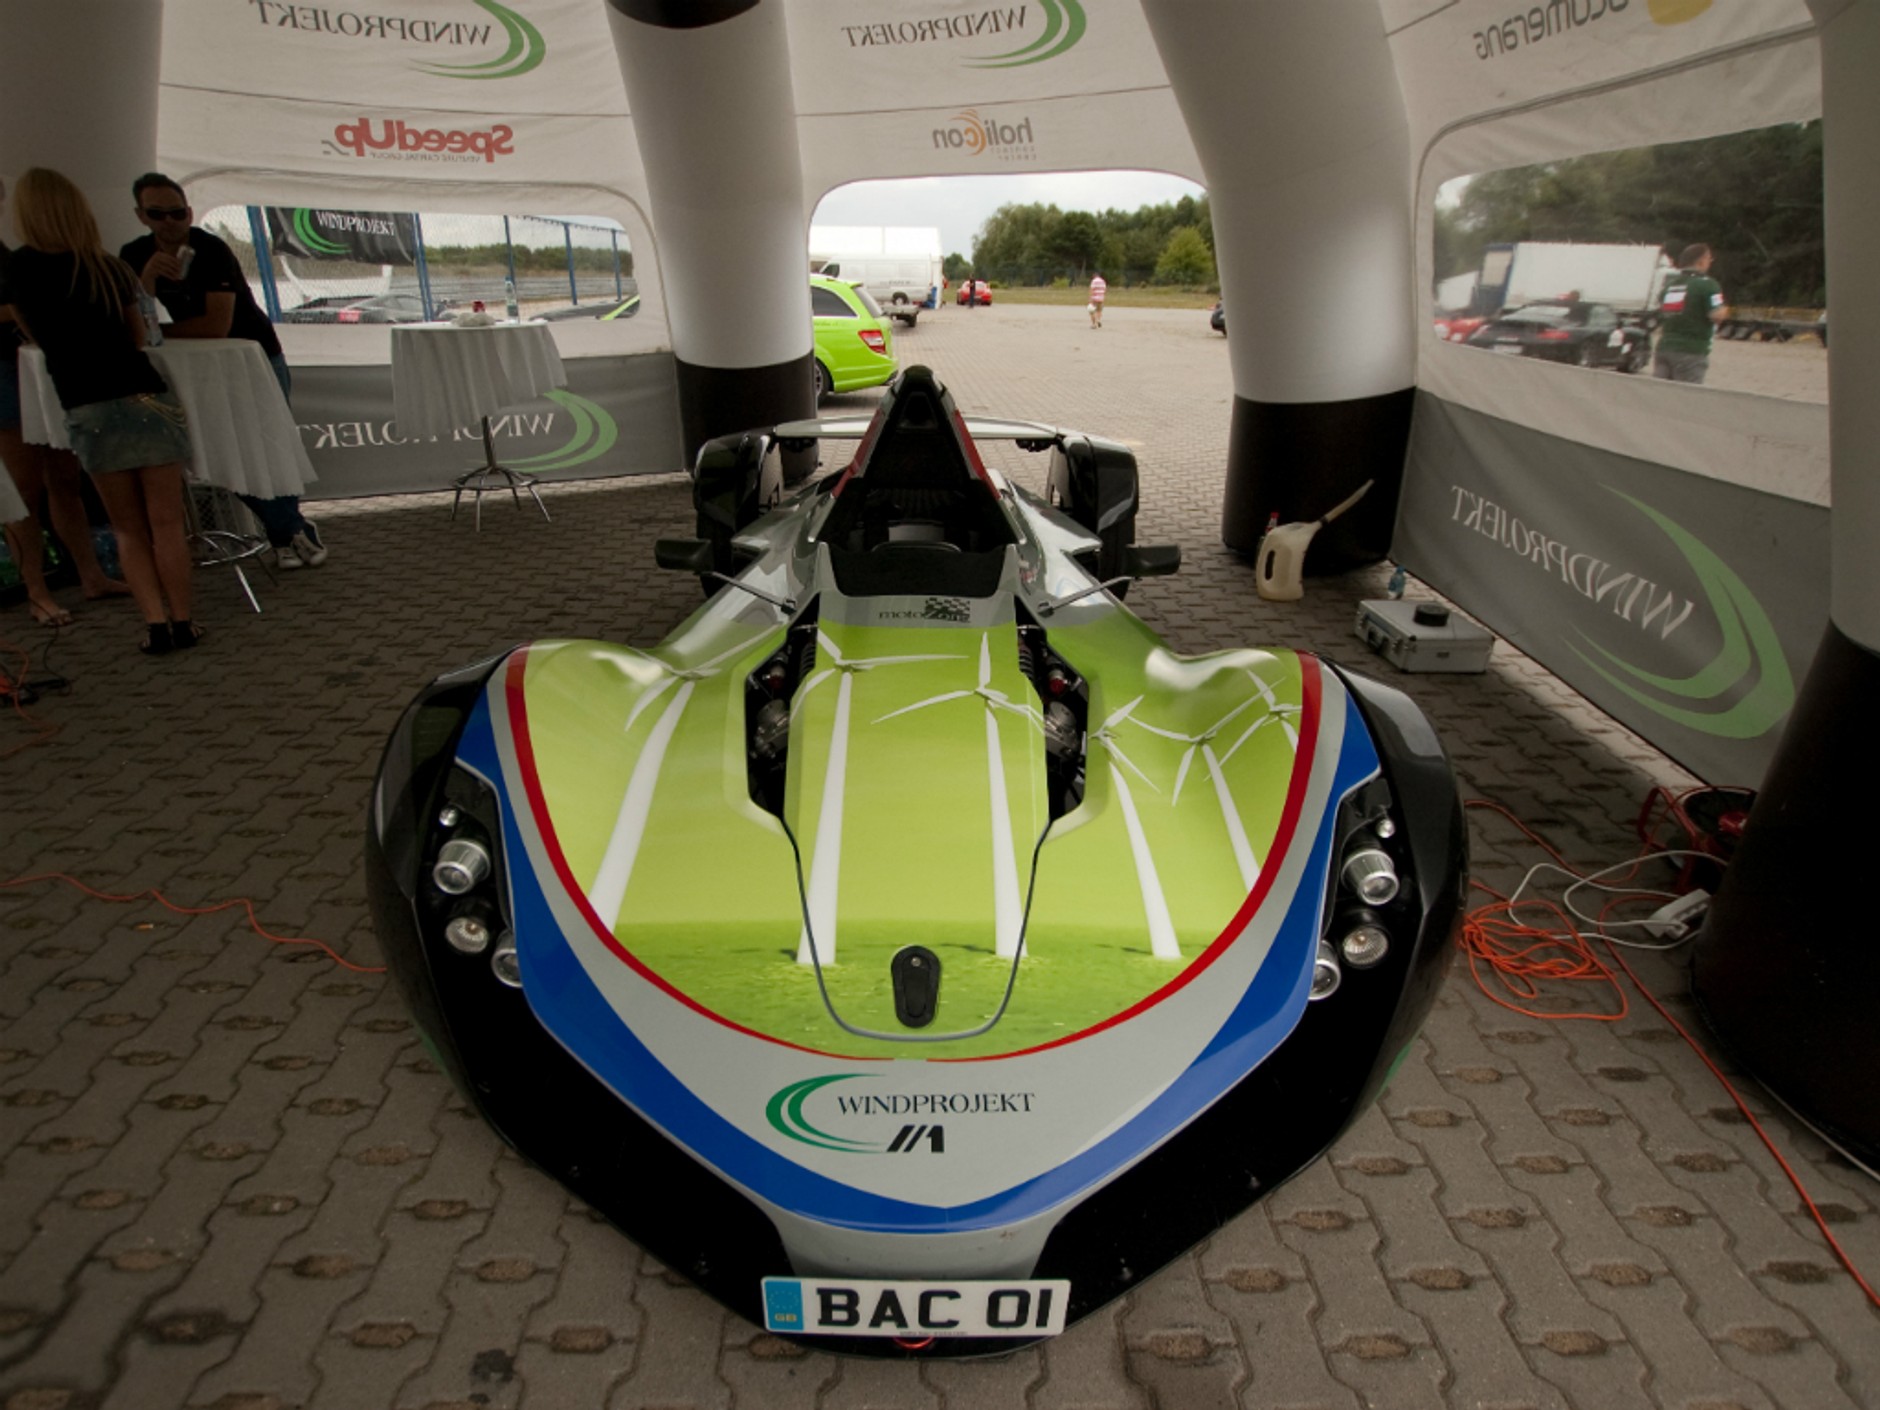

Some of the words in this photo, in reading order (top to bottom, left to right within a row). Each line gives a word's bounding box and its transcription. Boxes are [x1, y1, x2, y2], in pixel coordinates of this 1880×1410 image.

[316, 210, 396, 237] WINDPROJEKT
[837, 1092, 1036, 1116] WINDPROJEKT
[816, 1287, 962, 1329] BAC
